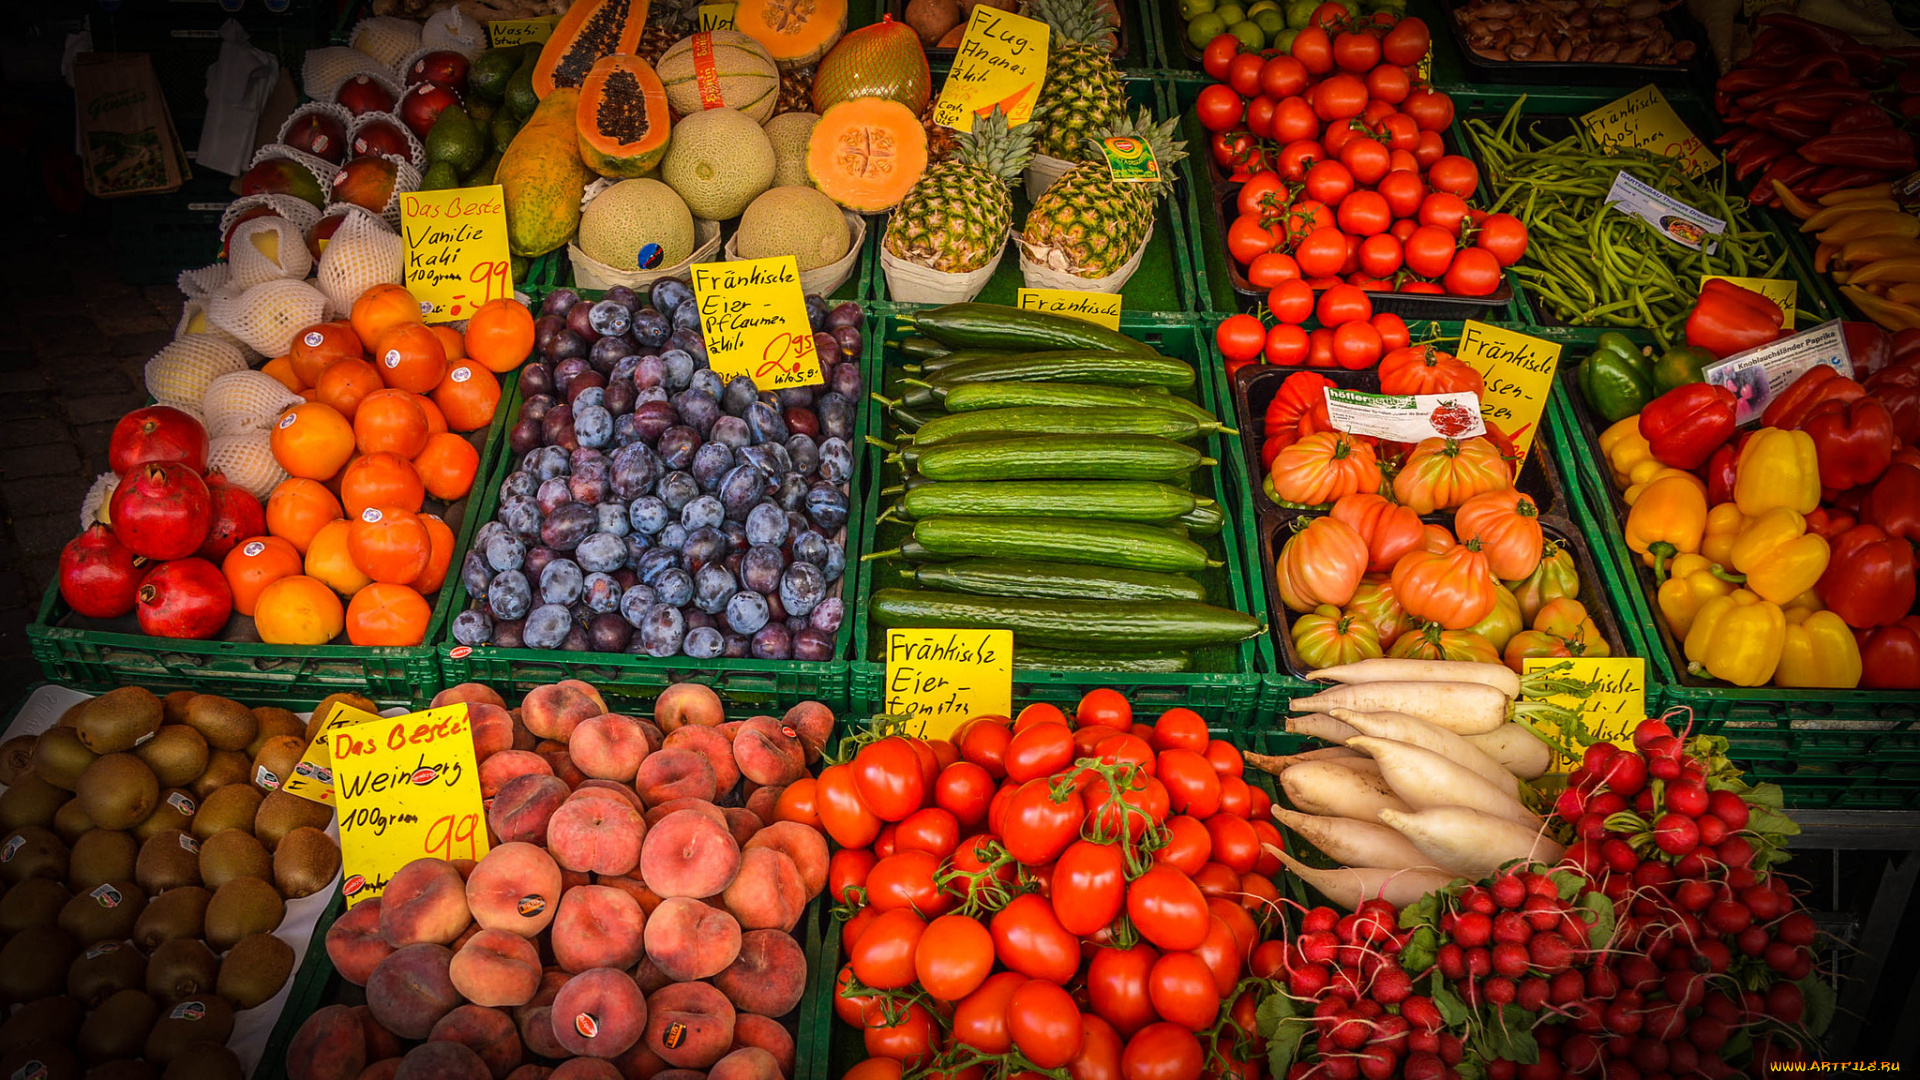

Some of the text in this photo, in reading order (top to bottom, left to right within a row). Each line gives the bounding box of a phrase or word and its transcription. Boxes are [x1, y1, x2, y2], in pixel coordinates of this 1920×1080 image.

[494, 24, 538, 36] Nashi
[962, 39, 1027, 75] Ananas
[406, 196, 502, 219] Das Beste
[1620, 172, 1662, 199] GARTENBAU
[1662, 194, 1690, 214] Thomas
[696, 265, 795, 292] Fränkische
[1737, 341, 1804, 370] Knoblauchsländer
[1805, 331, 1836, 347] Paprika
[335, 733, 377, 759] Das
[424, 813, 479, 862] 99
